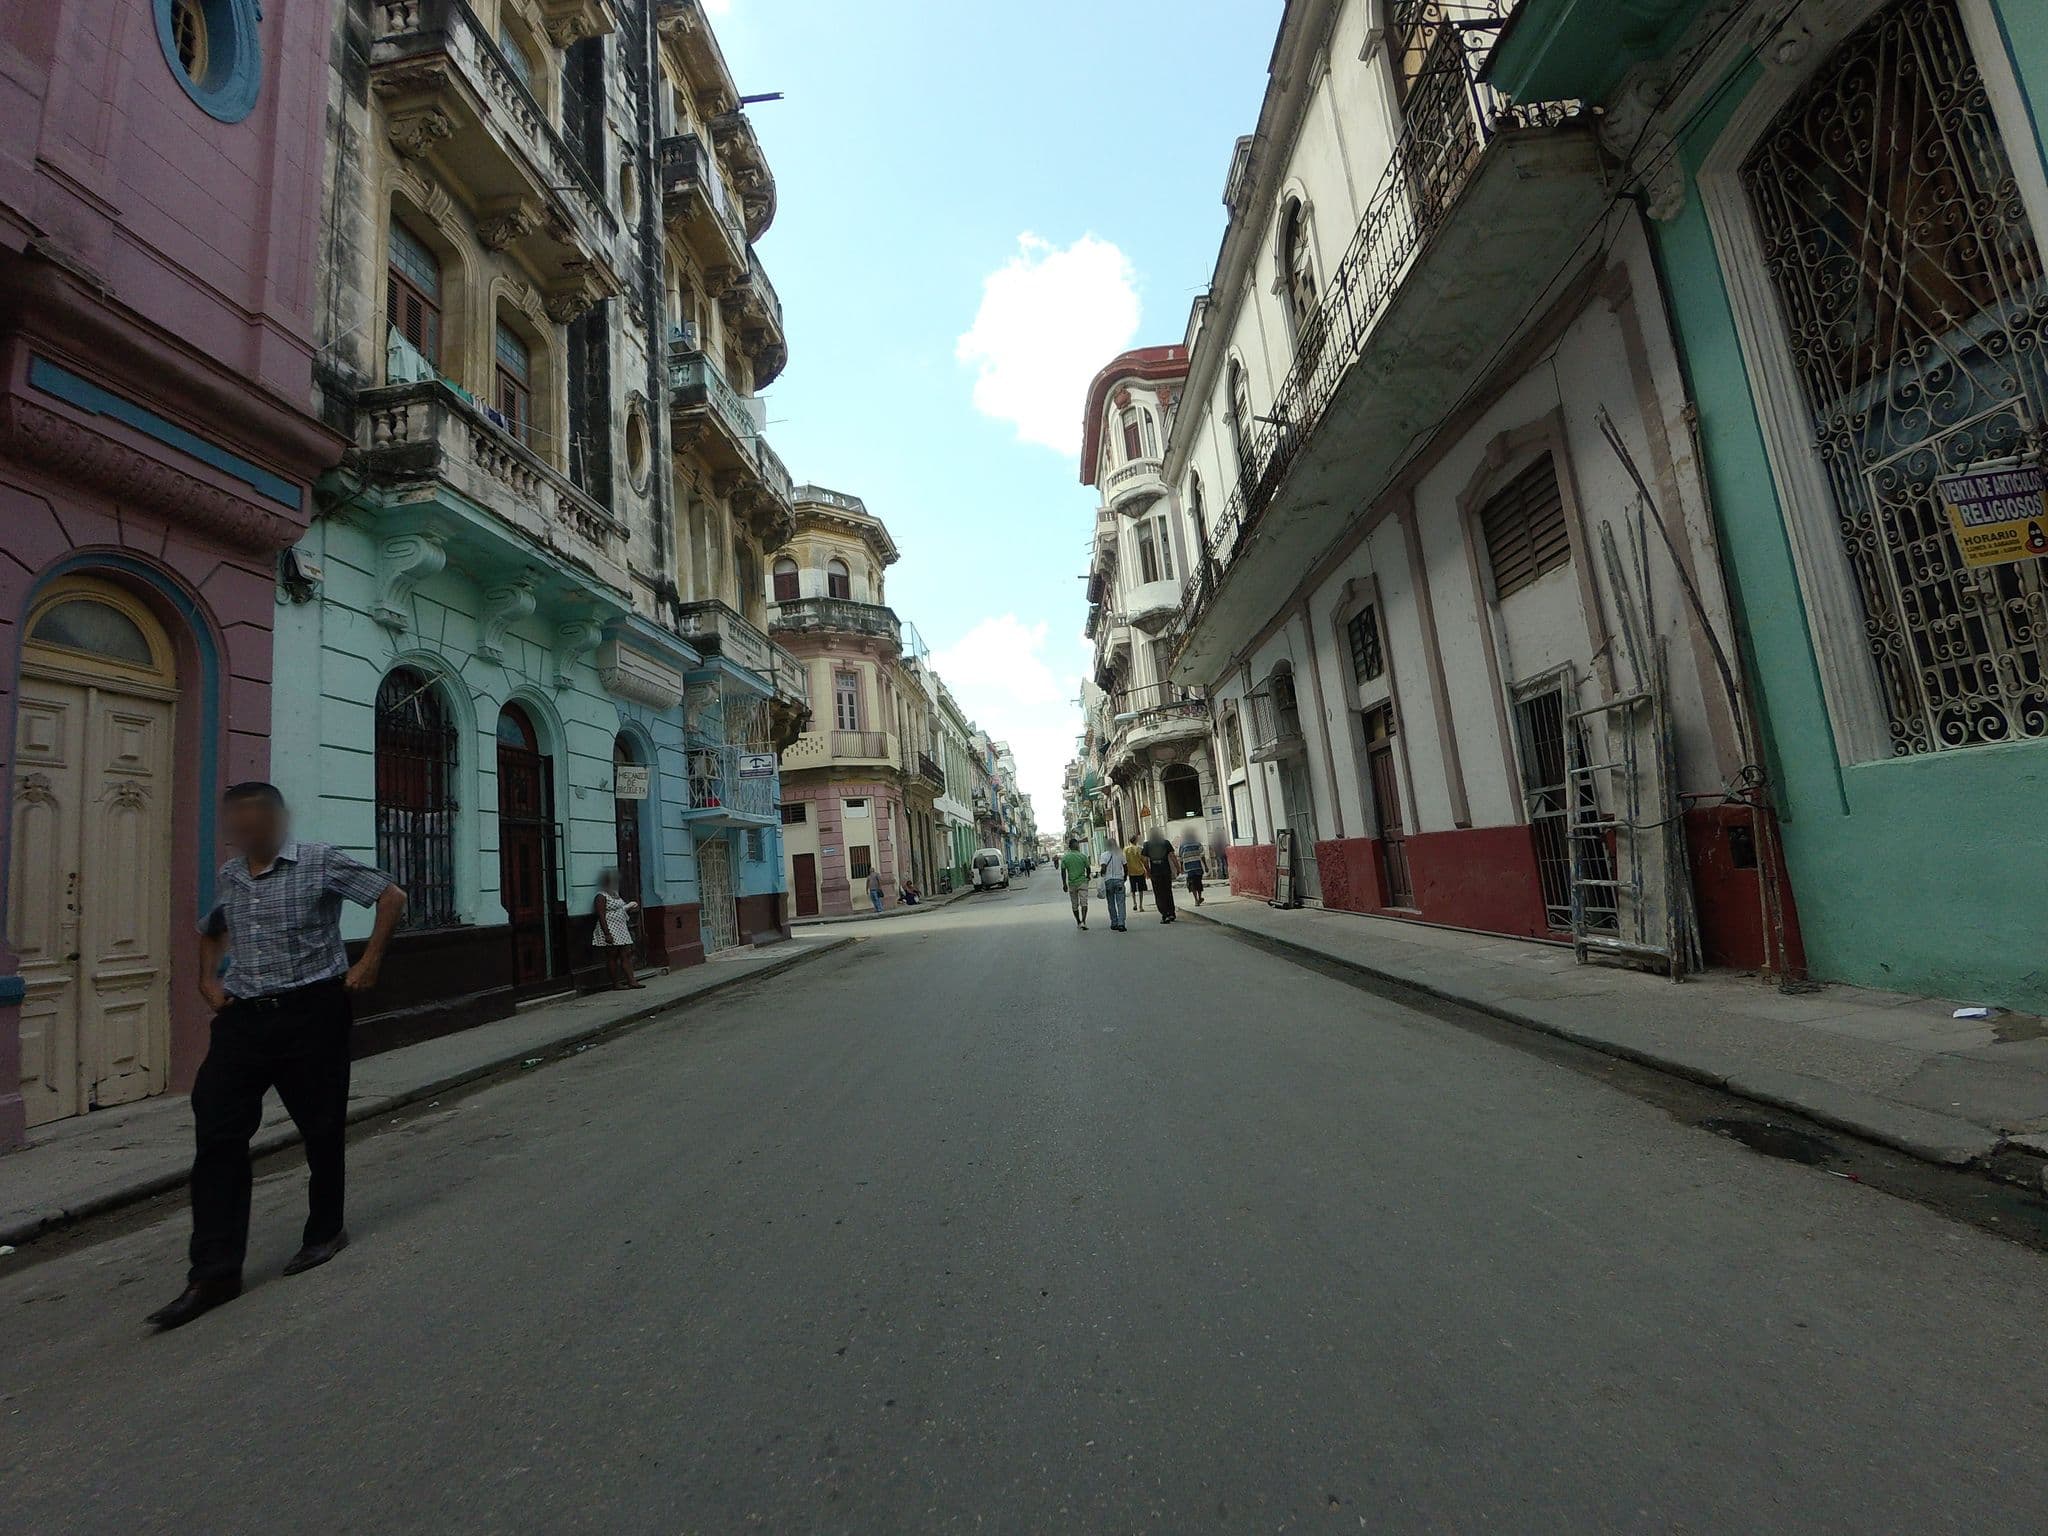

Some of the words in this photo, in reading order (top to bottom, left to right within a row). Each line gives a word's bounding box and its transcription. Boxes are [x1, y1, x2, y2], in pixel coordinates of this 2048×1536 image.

[1940, 480, 1979, 503] VENTA
[1975, 477, 1994, 498] DE
[1992, 470, 2044, 496] ARTICULOS
[1959, 495, 2043, 526] RELIGIOSOS
[1963, 529, 2018, 546] HORARIO
[627, 779, 638, 787] DE
